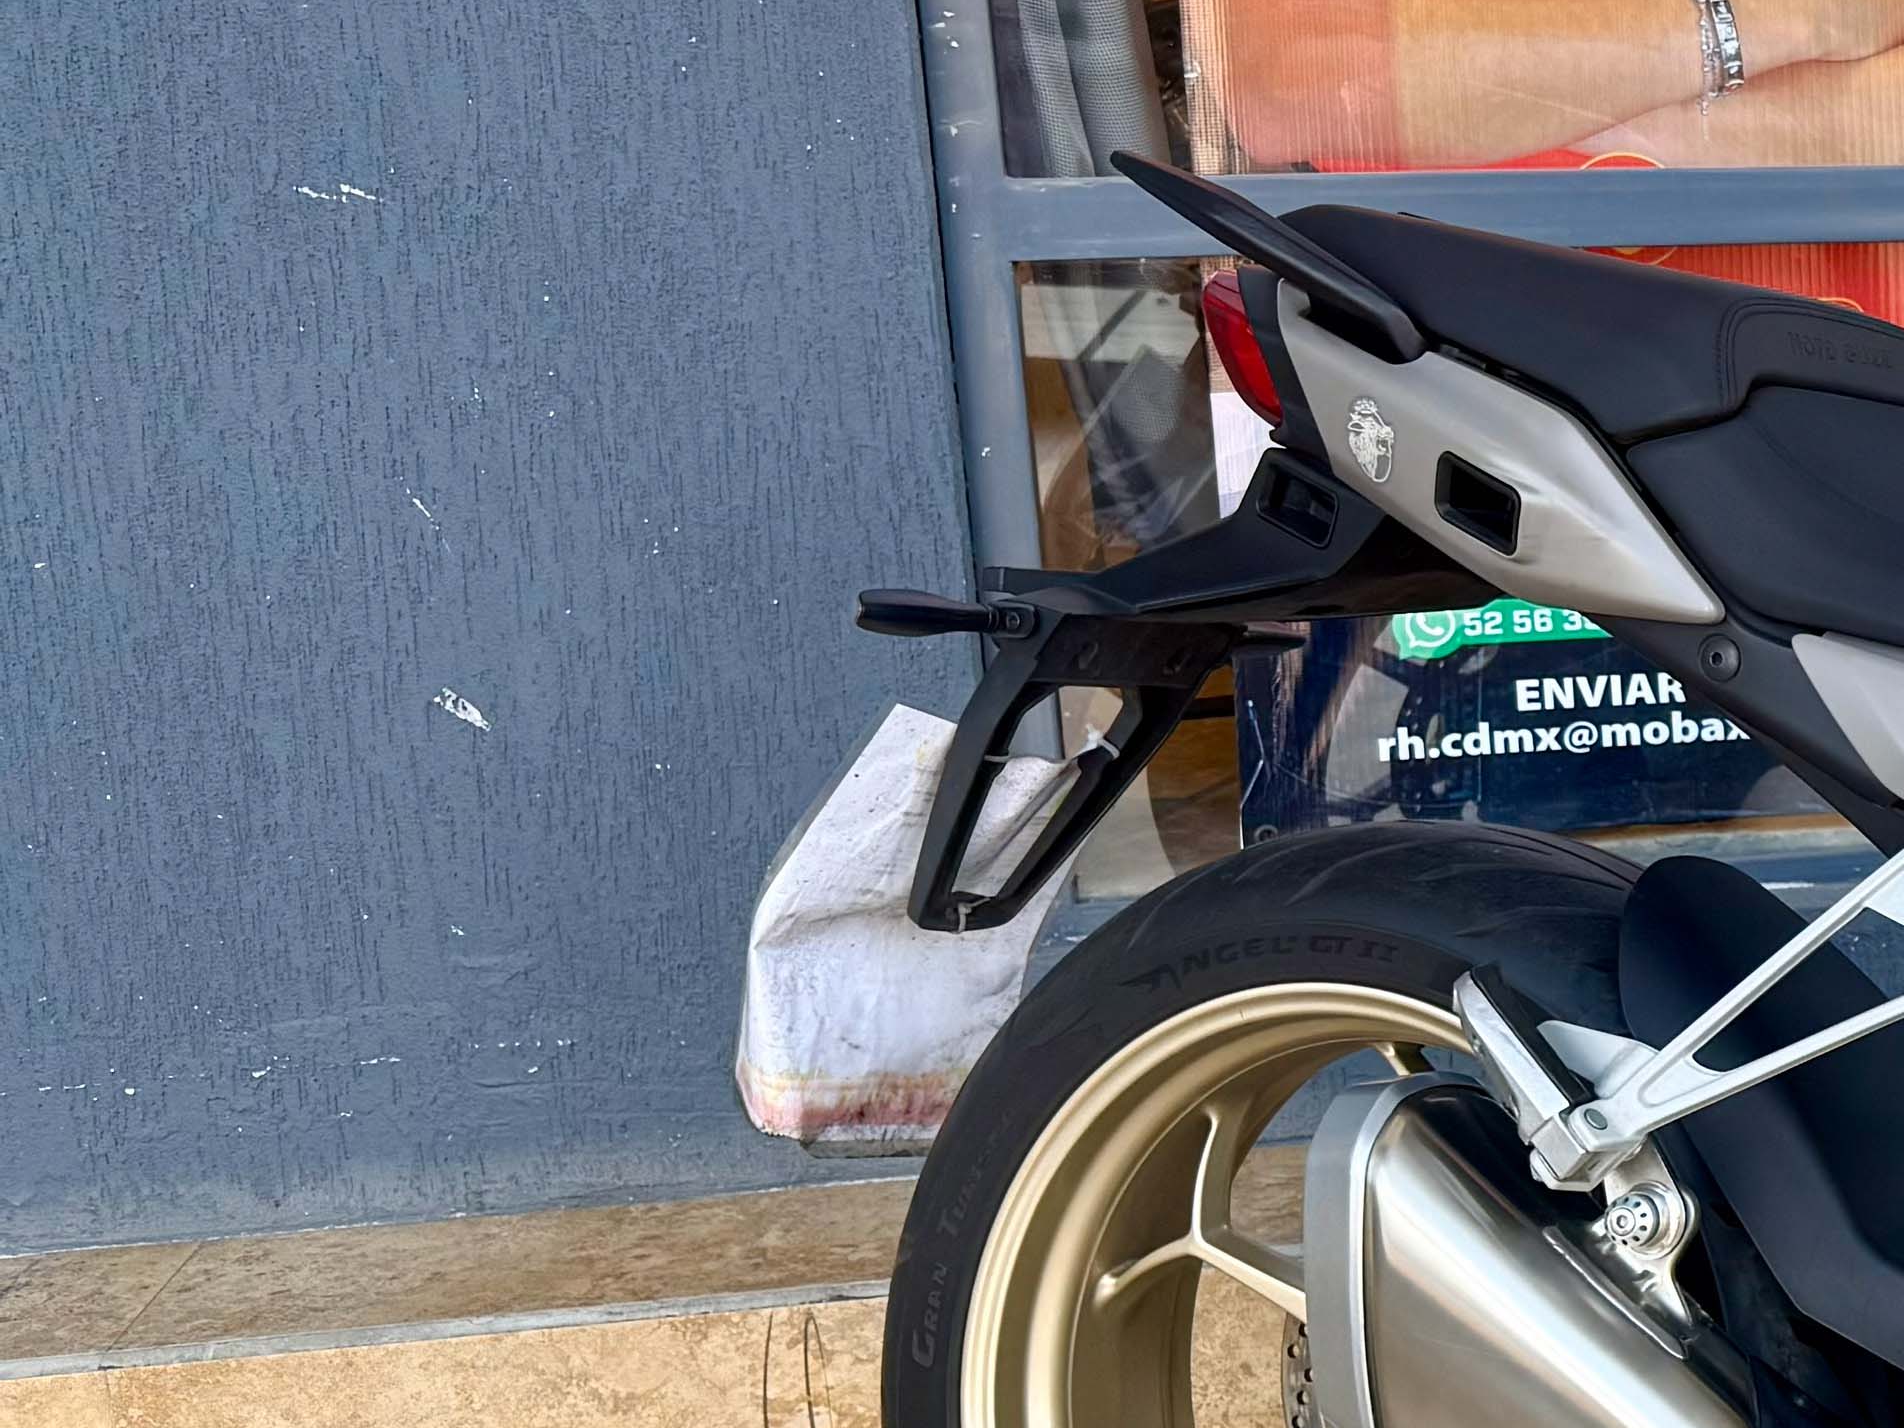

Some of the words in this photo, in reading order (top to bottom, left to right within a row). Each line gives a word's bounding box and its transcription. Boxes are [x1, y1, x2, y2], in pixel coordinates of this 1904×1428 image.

[1462, 611, 1504, 636] 52
[1512, 608, 1554, 633] 56
[1562, 608, 1602, 631] 3
[1515, 671, 1687, 712] ENVIAR
[912, 1260, 949, 1369] GRAN
